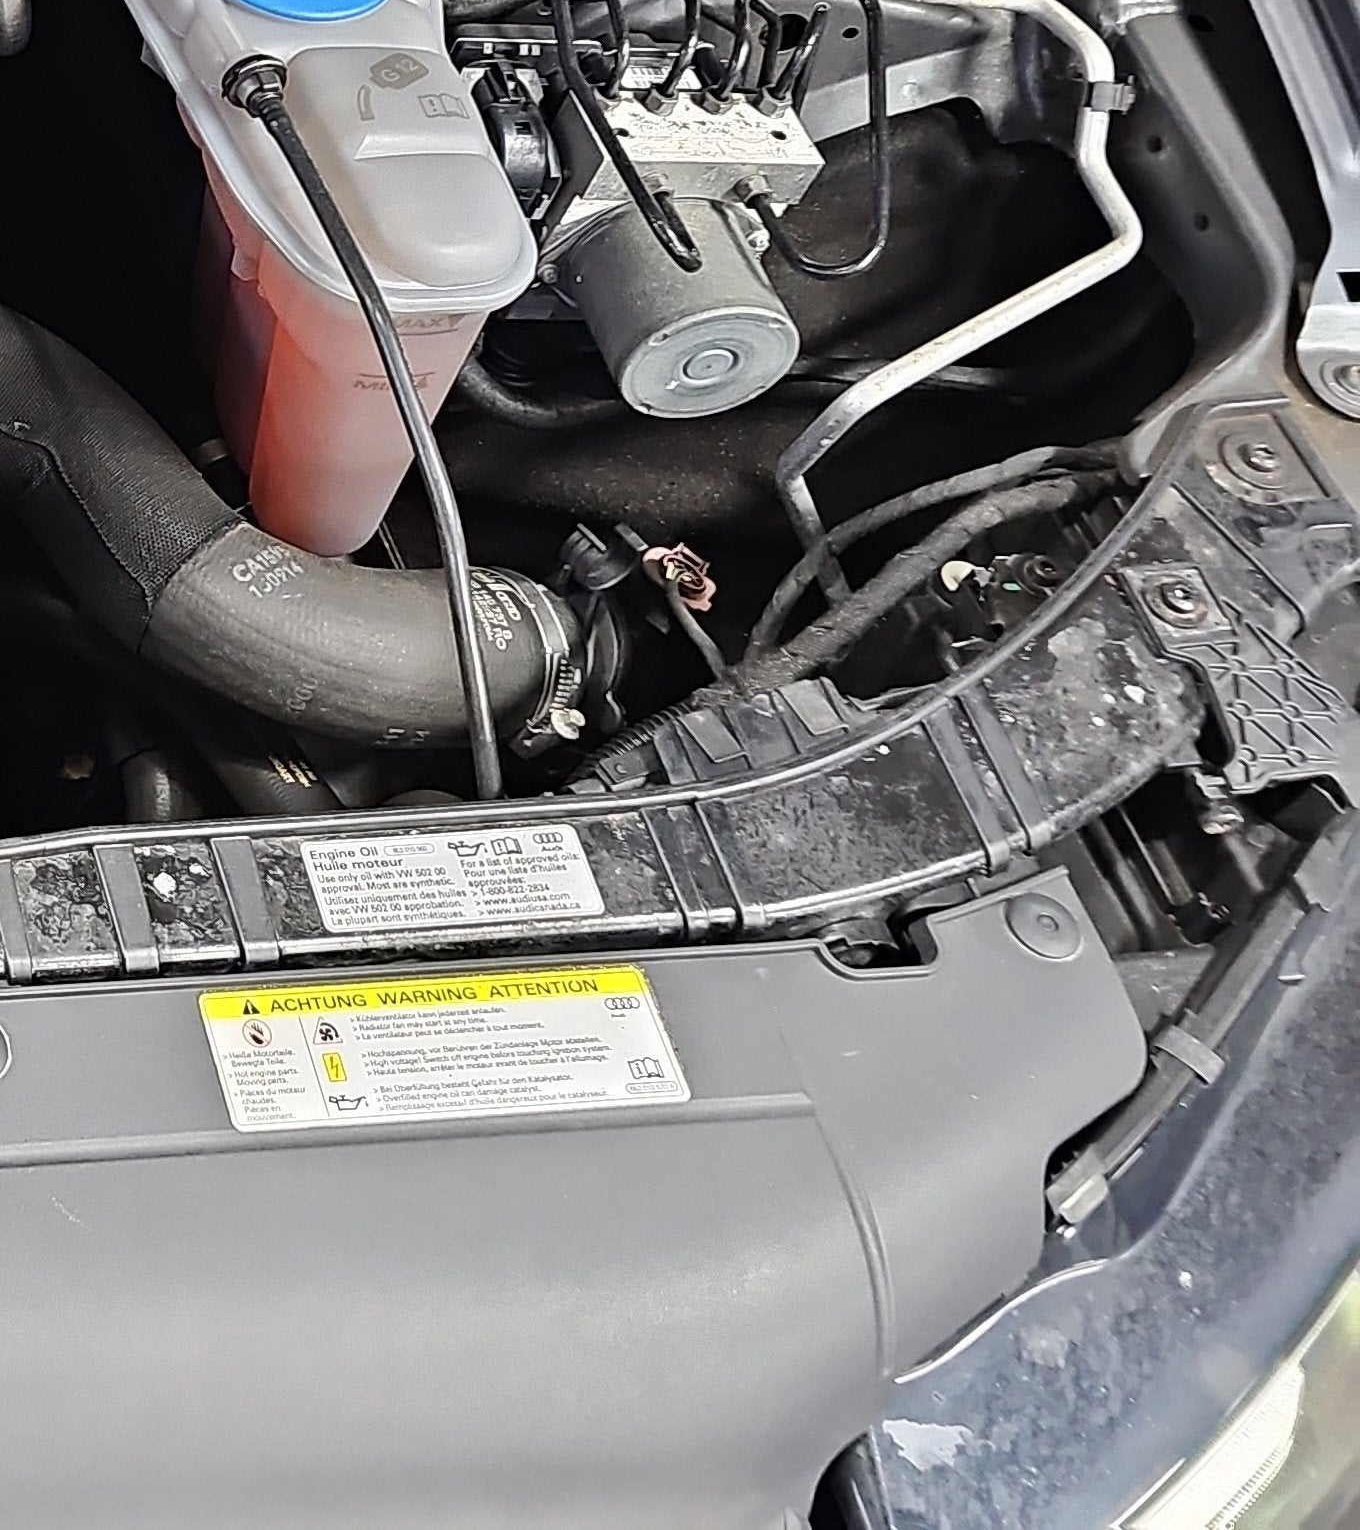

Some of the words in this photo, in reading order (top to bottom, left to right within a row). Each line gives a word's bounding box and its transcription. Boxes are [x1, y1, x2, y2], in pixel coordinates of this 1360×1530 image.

[381, 58, 419, 81] G12
[310, 849, 355, 860] Engine
[360, 847, 378, 856] Oil
[313, 860, 348, 871] Huile
[352, 859, 403, 869] moteur
[460, 859, 476, 868] For
[486, 858, 500, 867] list
[503, 857, 513, 865] of
[515, 854, 559, 867] approved
[317, 875, 335, 883] Use
[338, 873, 358, 883] only
[361, 872, 372, 881] oil
[374, 870, 394, 880] with
[395, 869, 412, 878] VW
[415, 868, 432, 877] 502
[434, 867, 446, 875] 00
[464, 869, 486, 878] Pour
[508, 866, 528, 875] liste
[366, 882, 391, 890] Most
[324, 896, 359, 905] Utilisez
[361, 892, 418, 903] uniquement
[420, 891, 436, 899] des
[438, 889, 467, 899] huiles
[483, 893, 571, 906] www.audiusa.com
[351, 904, 368, 914] VW
[371, 903, 388, 912] 502
[390, 903, 401, 911] 00
[487, 902, 581, 916] www.audicanada.ca
[331, 917, 343, 926] La
[345, 915, 379, 926] plupart
[381, 914, 402, 922] sont
[270, 993, 367, 1013] ACHTUNG
[377, 986, 477, 1006] WARNING
[489, 978, 599, 1000] ATTENTION
